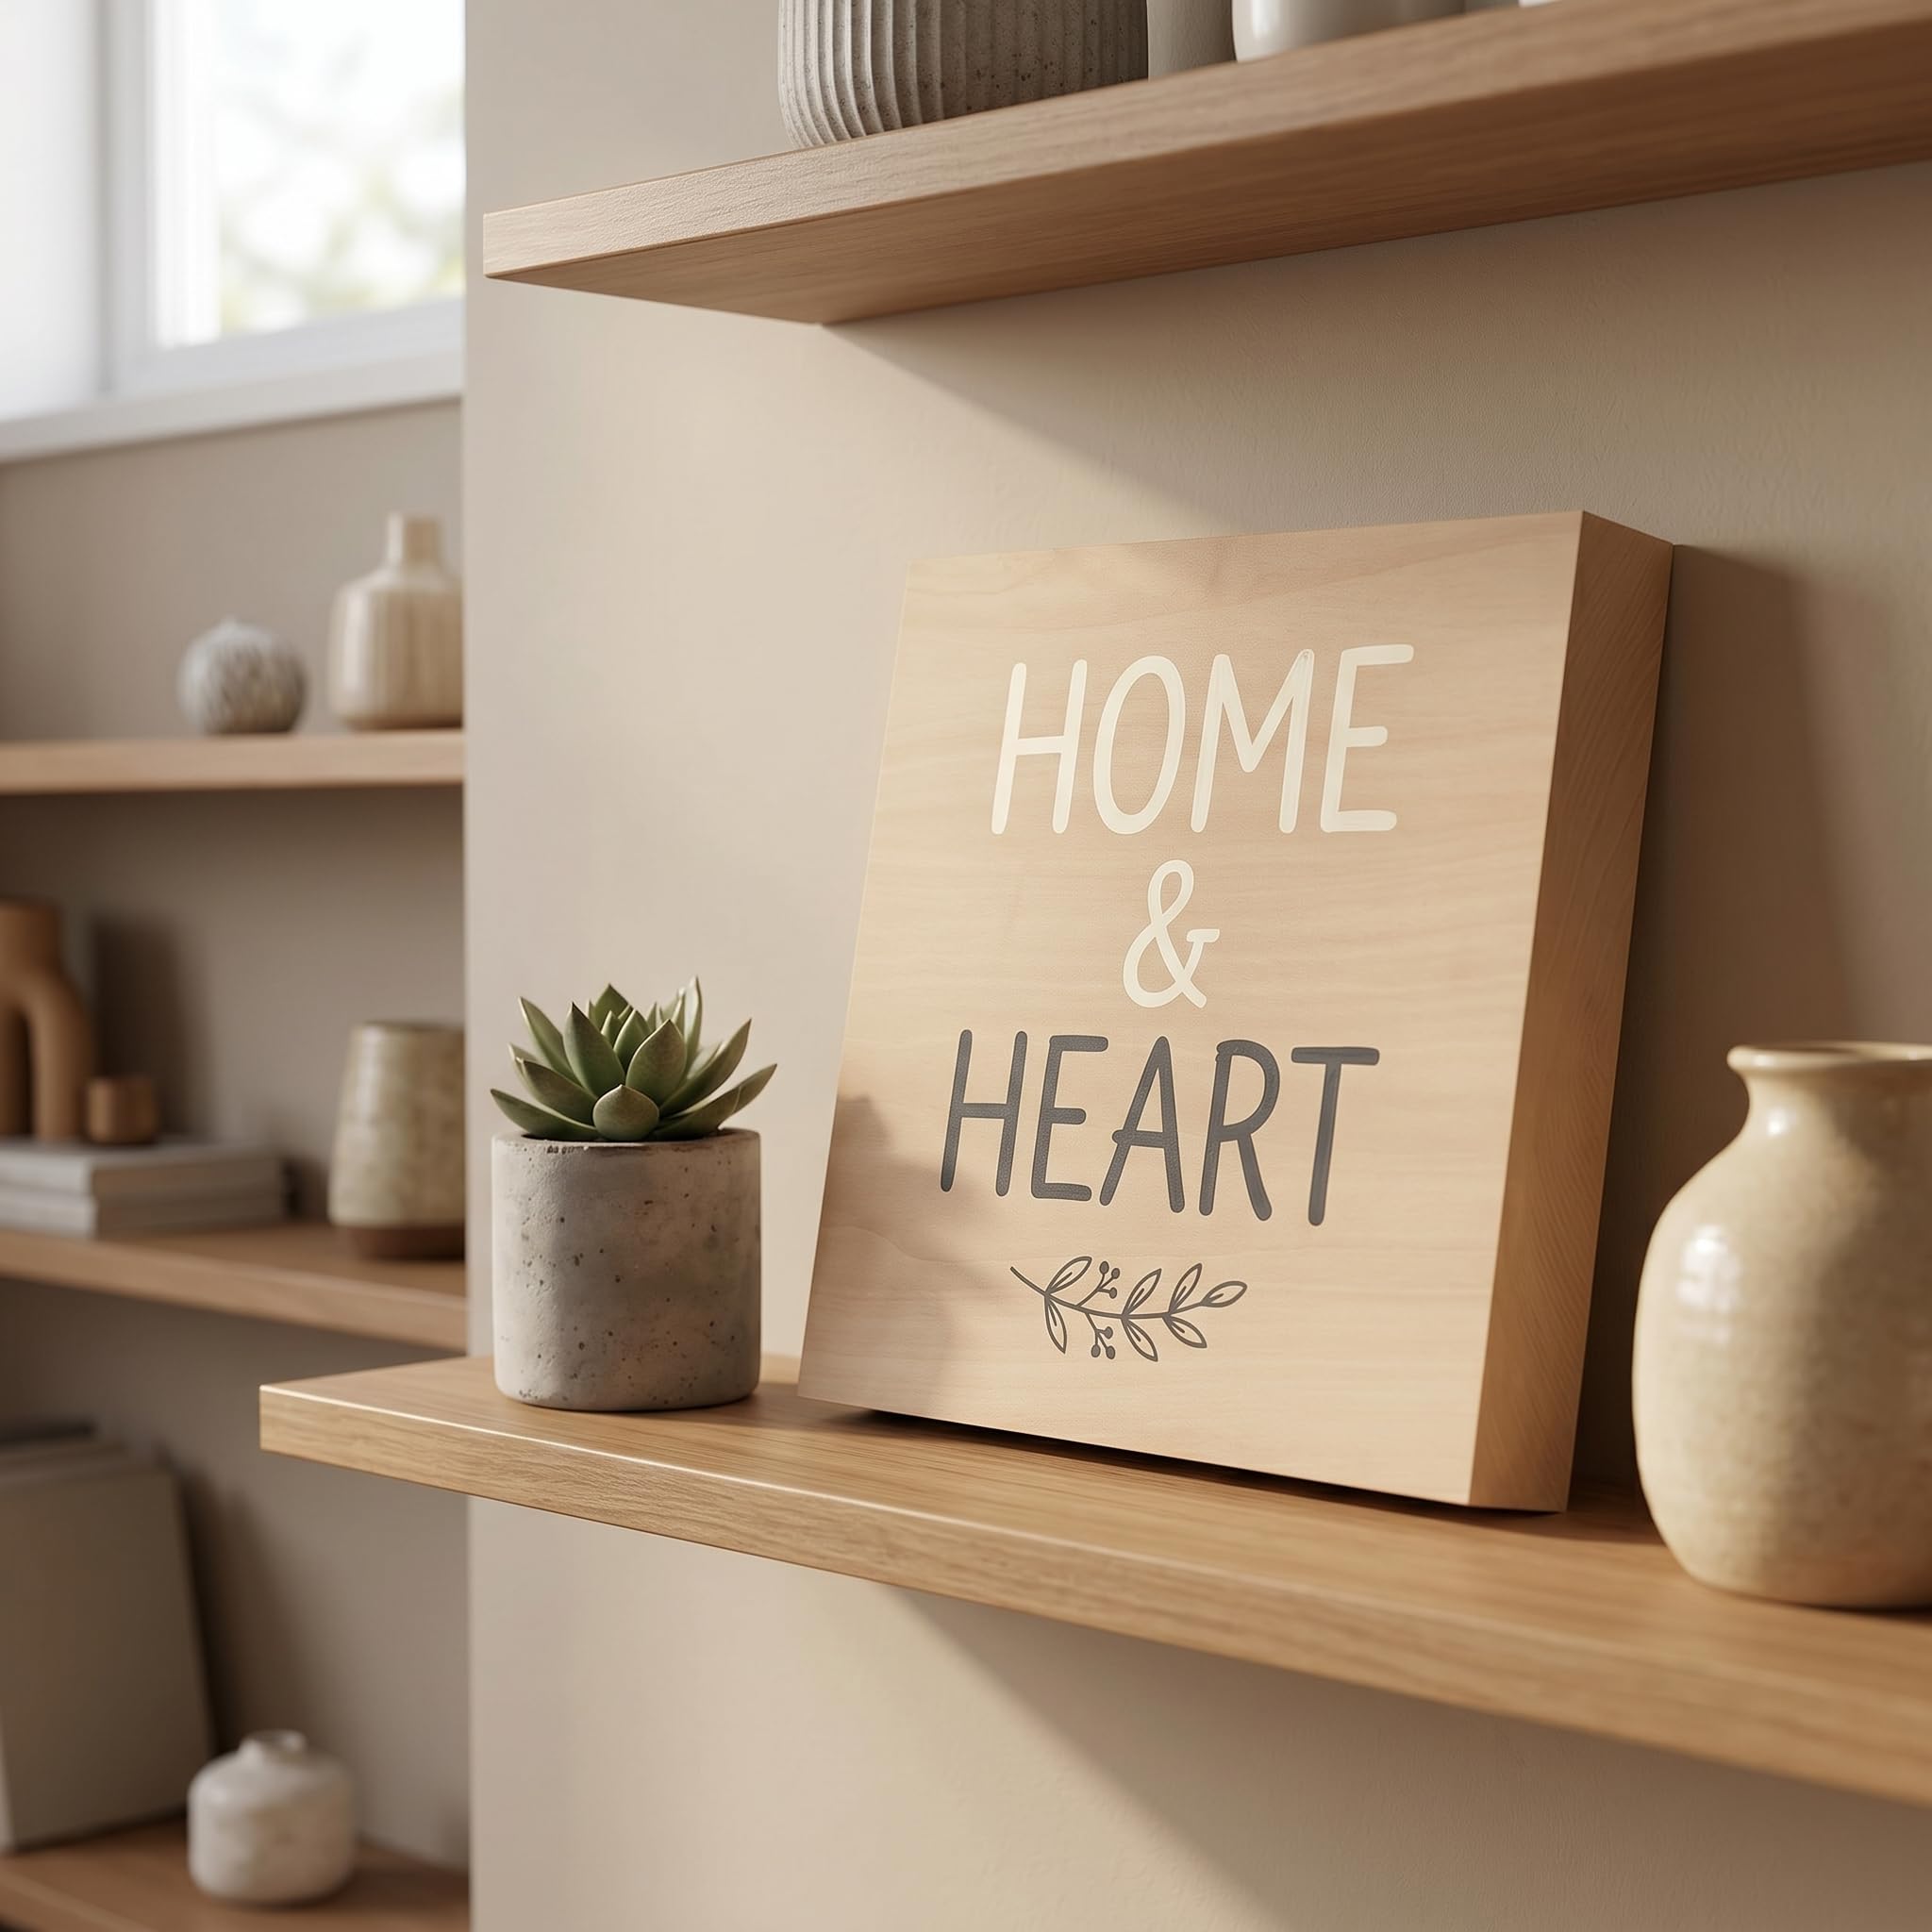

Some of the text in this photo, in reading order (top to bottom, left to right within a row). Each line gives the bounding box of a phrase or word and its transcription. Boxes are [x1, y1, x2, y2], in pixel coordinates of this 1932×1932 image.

[991, 643, 1414, 834] HOME
[1123, 859, 1220, 1008] &
[940, 1029, 1380, 1226] HEART
